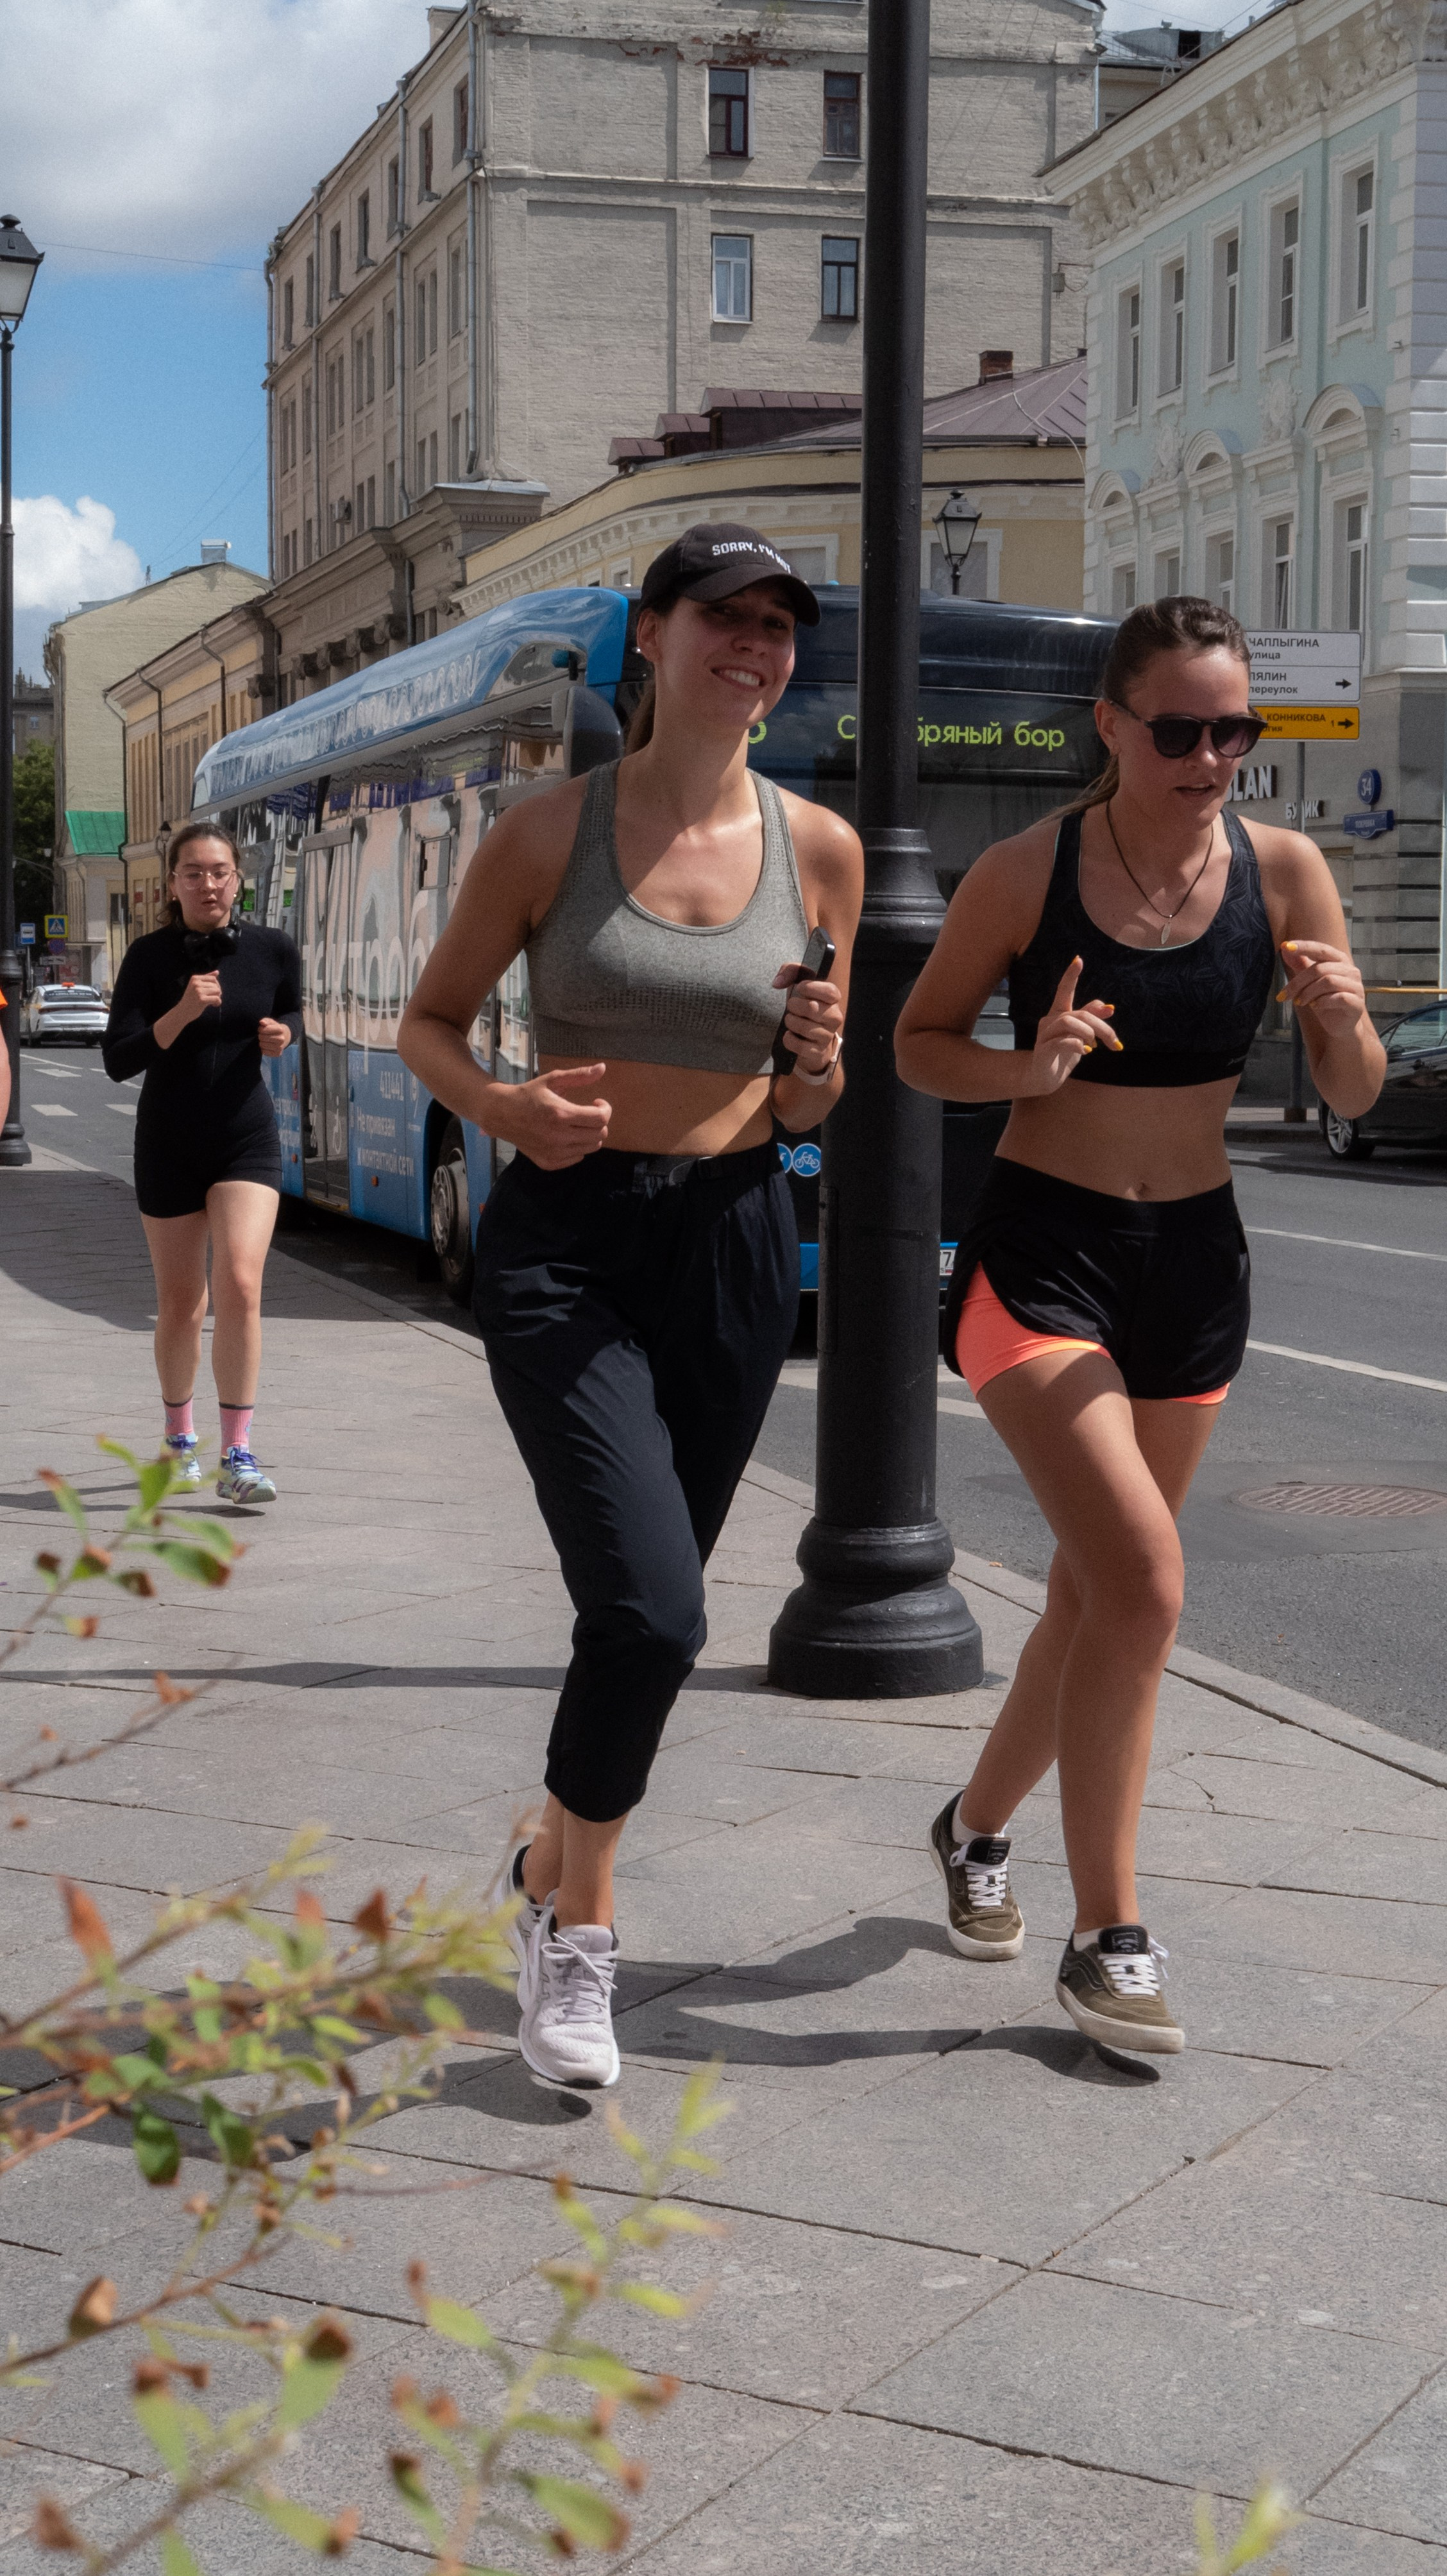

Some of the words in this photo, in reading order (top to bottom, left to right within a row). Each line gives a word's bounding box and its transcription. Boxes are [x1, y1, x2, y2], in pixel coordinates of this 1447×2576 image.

[712, 541, 757, 556] SORRY,
[1249, 638, 1319, 648] ЧАПЛЫГИНА
[1249, 652, 1281, 661] улица
[1249, 686, 1298, 695] переулок
[1267, 713, 1326, 722] КОННИКОВА
[1014, 721, 1065, 752] бор
[1361, 777, 1372, 796] 34
[1285, 801, 1319, 820] БУИК
